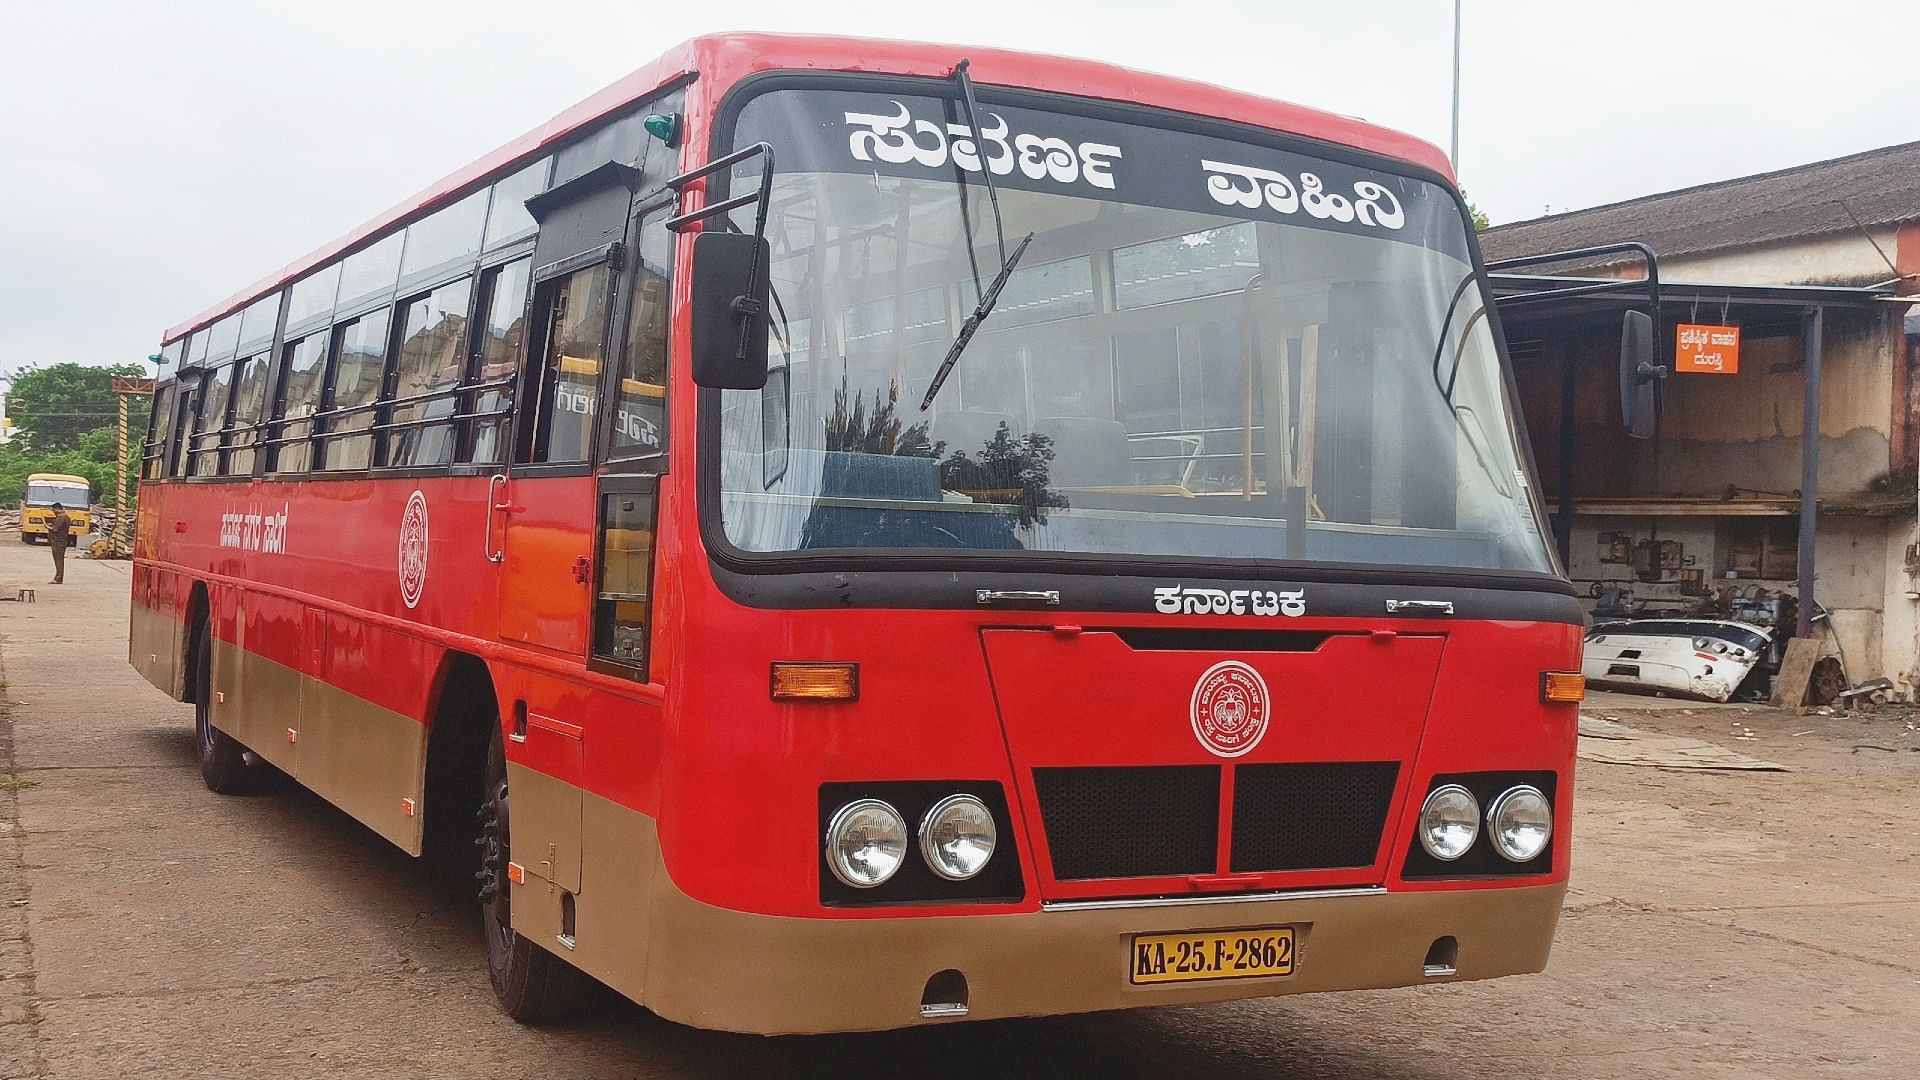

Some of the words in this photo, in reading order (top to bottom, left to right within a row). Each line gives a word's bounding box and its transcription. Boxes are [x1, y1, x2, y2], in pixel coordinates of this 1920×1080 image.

[843, 100, 1121, 190] ಸುವರ್ಣ
[1201, 159, 1406, 230] ವಾಹಿನಿ
[262, 501, 289, 555] ಸಾರಿಗೆ
[1154, 583, 1306, 617] ಕರ್ನಾಟಕ
